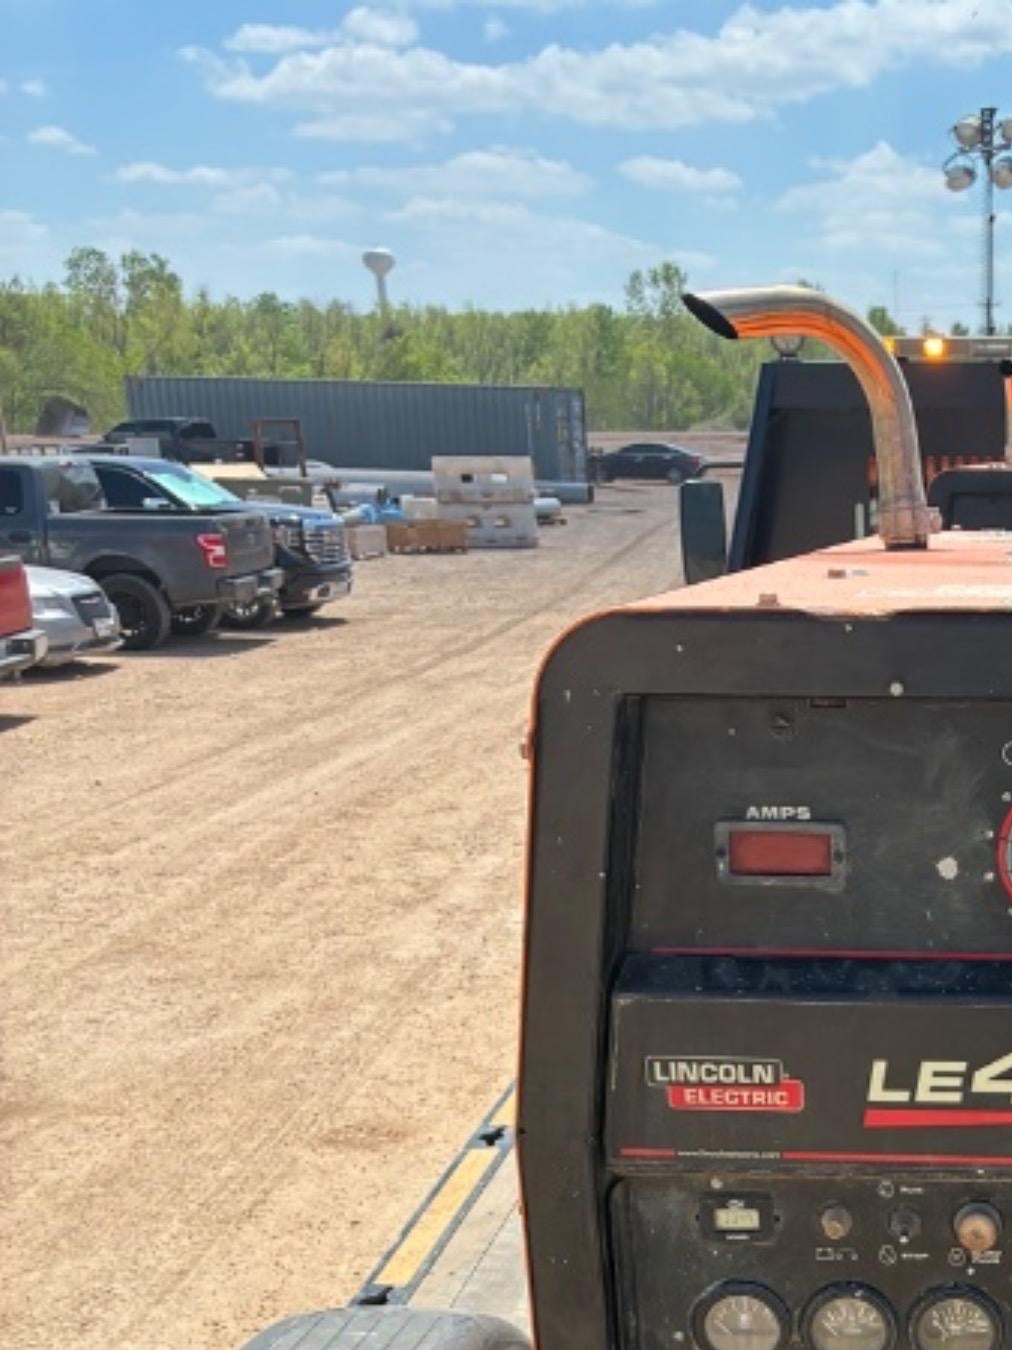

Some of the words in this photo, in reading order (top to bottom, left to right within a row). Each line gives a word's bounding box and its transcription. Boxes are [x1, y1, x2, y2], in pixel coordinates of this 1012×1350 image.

[745, 805, 811, 820] AMPS
[652, 1060, 776, 1085] LINCOLN
[682, 1087, 790, 1106] ELECTRIC
